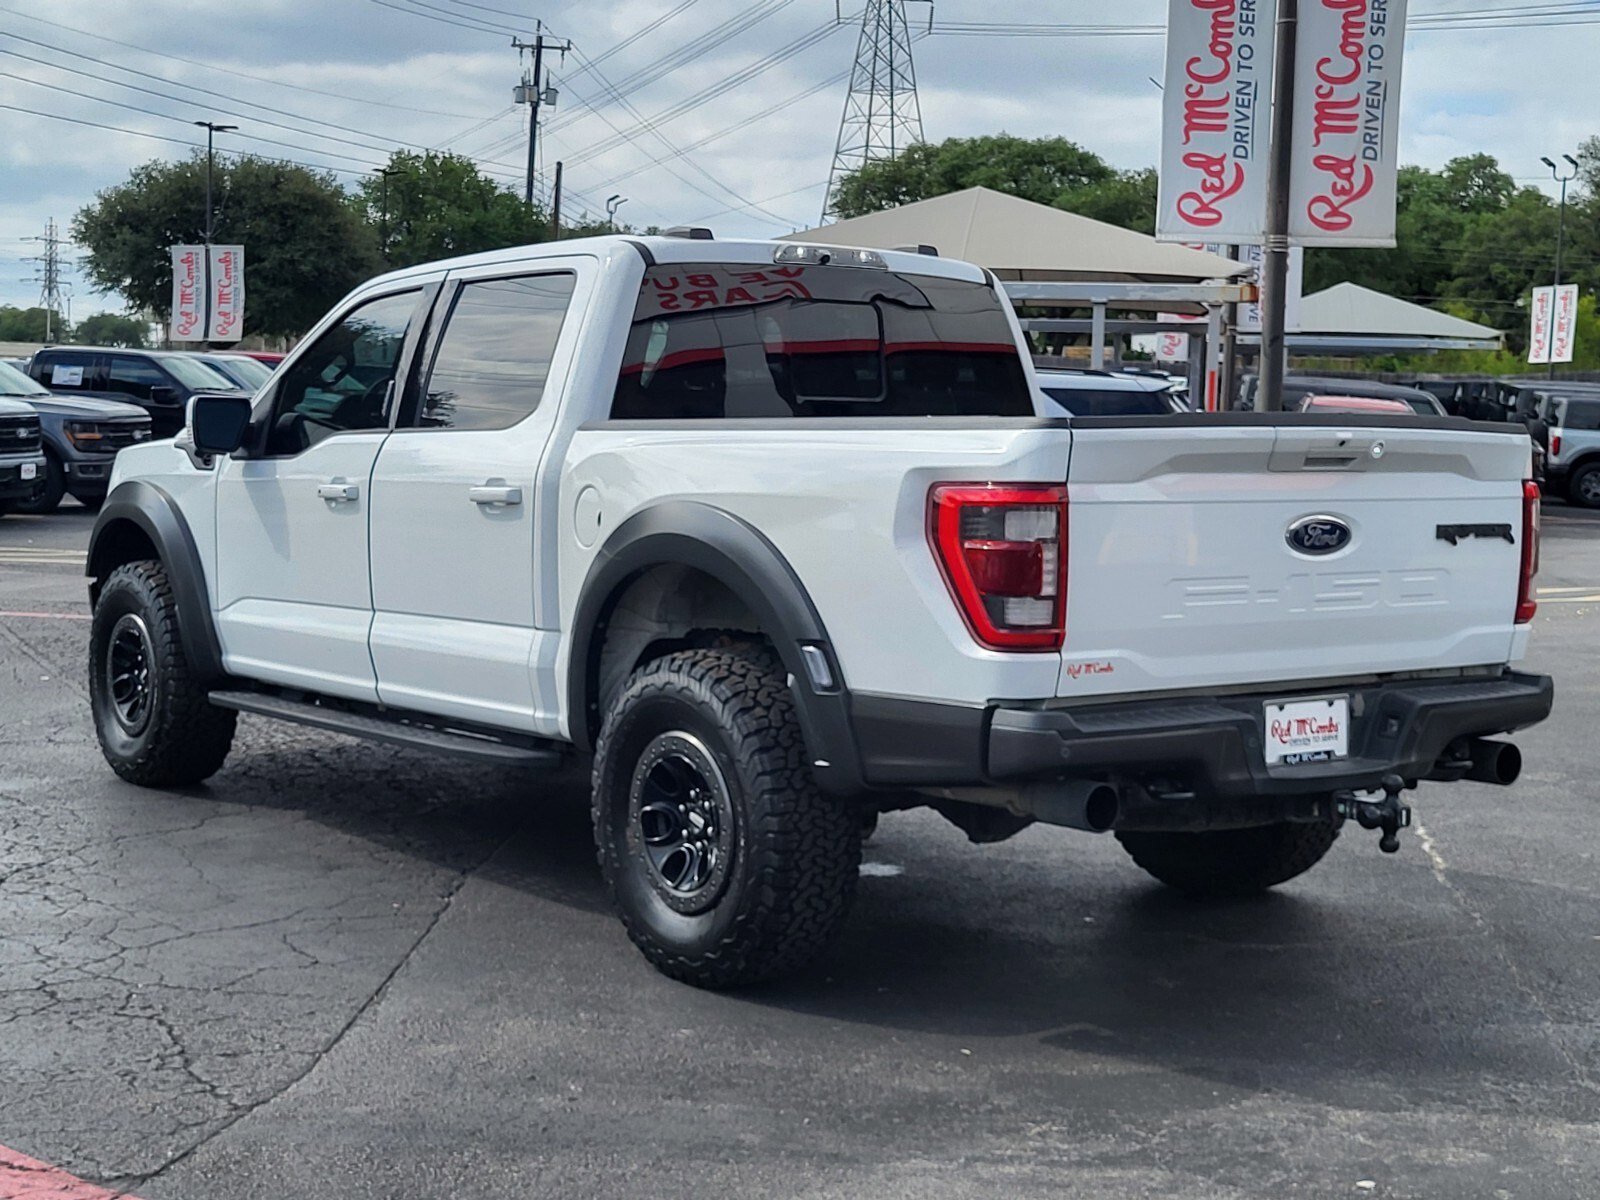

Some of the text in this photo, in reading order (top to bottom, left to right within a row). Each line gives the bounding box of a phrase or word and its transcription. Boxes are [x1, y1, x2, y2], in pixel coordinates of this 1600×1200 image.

[1237, 43, 1254, 73] TO
[1368, 44, 1384, 73] TO
[1233, 80, 1253, 159] DRIVEN
[1362, 80, 1383, 161] DRIVEN
[1176, 153, 1244, 227] Red
[1307, 154, 1374, 232] Red
[177, 252, 198, 335] Red McCombs
[216, 251, 236, 335] Red McCombs
[1304, 523, 1340, 546] Ford
[1271, 718, 1292, 744] Red
